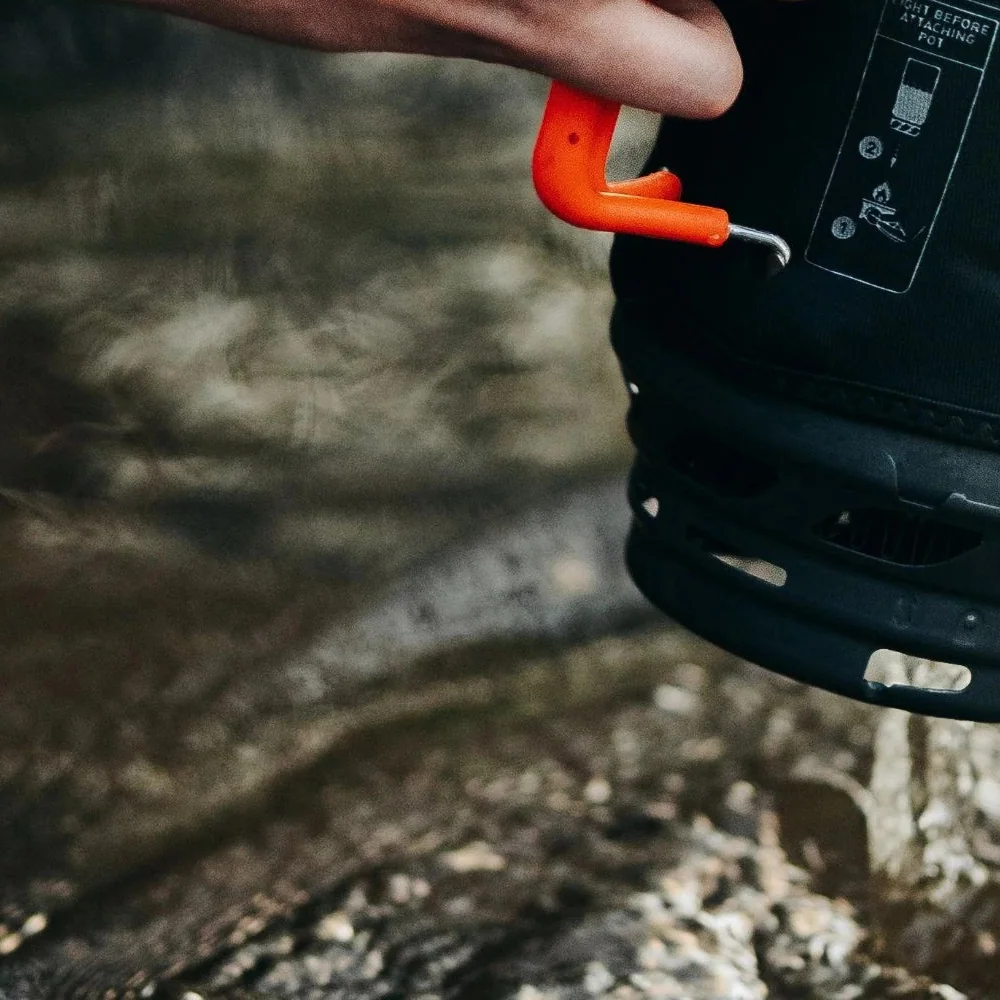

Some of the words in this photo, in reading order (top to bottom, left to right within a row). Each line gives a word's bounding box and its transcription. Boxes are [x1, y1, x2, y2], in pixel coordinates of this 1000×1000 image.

[900, 12, 975, 44] ATTACHING
[934, 9, 990, 36] BEFORE
[918, 32, 943, 48] POT
